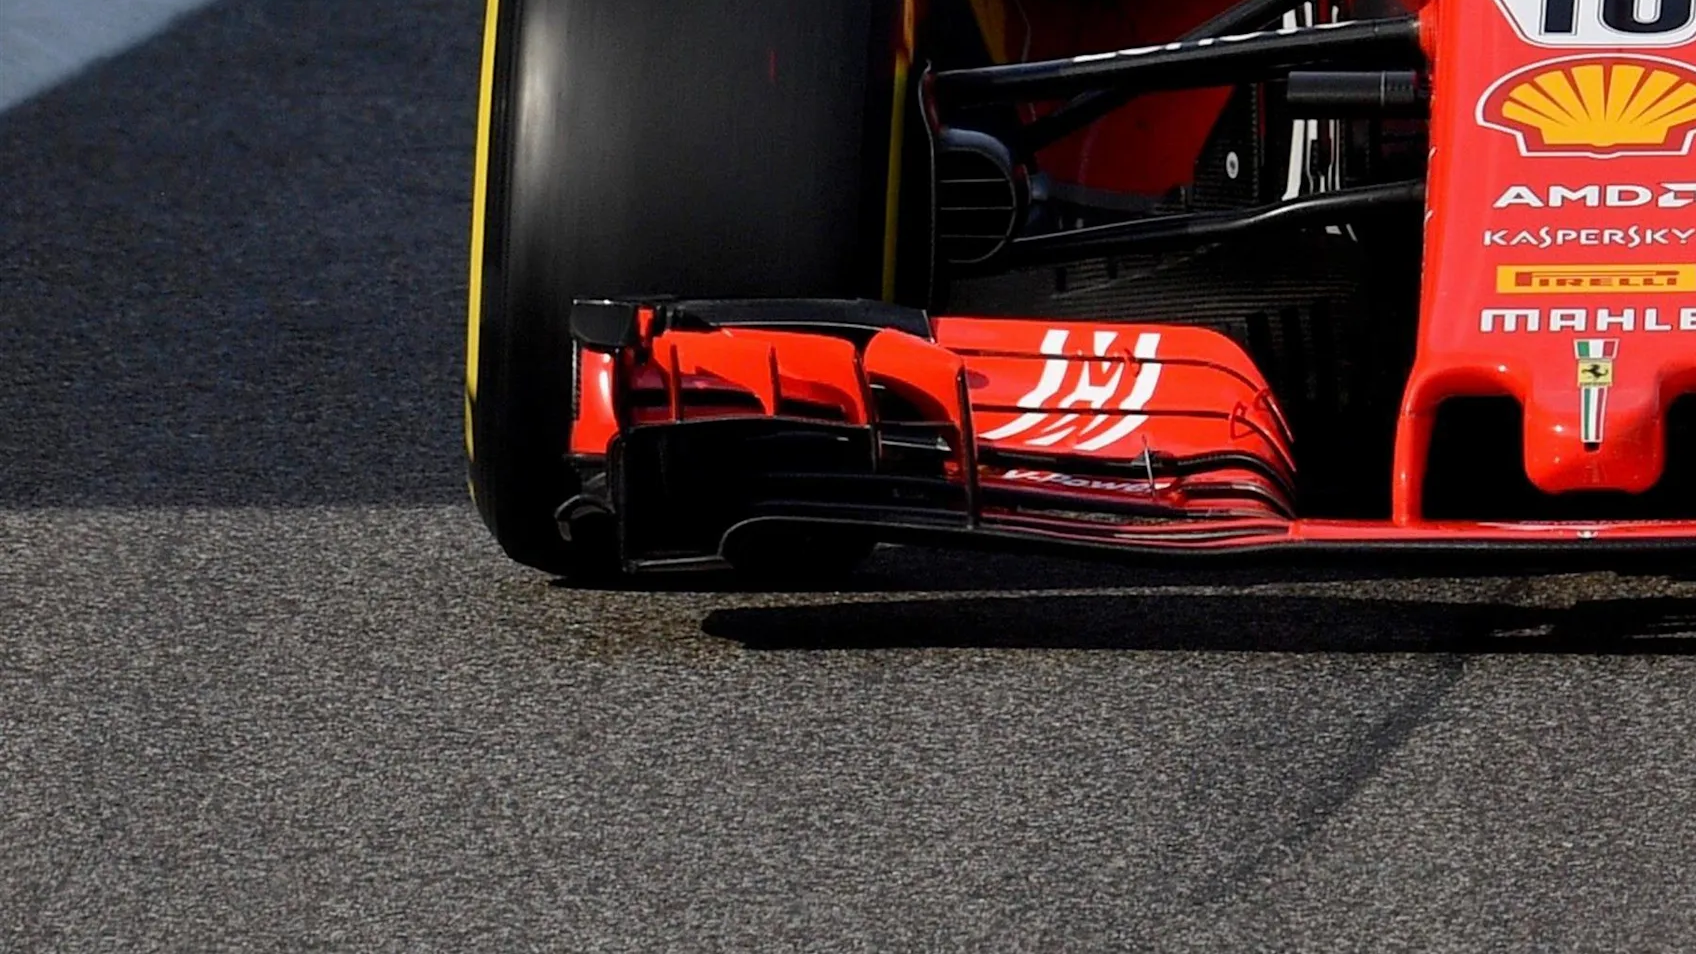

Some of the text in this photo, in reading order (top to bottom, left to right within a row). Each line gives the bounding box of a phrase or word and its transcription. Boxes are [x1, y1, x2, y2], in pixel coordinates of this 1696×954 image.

[1492, 183, 1653, 209] AMD
[1482, 226, 1696, 249] KASPERSKY
[1513, 270, 1681, 288] PIRELLI
